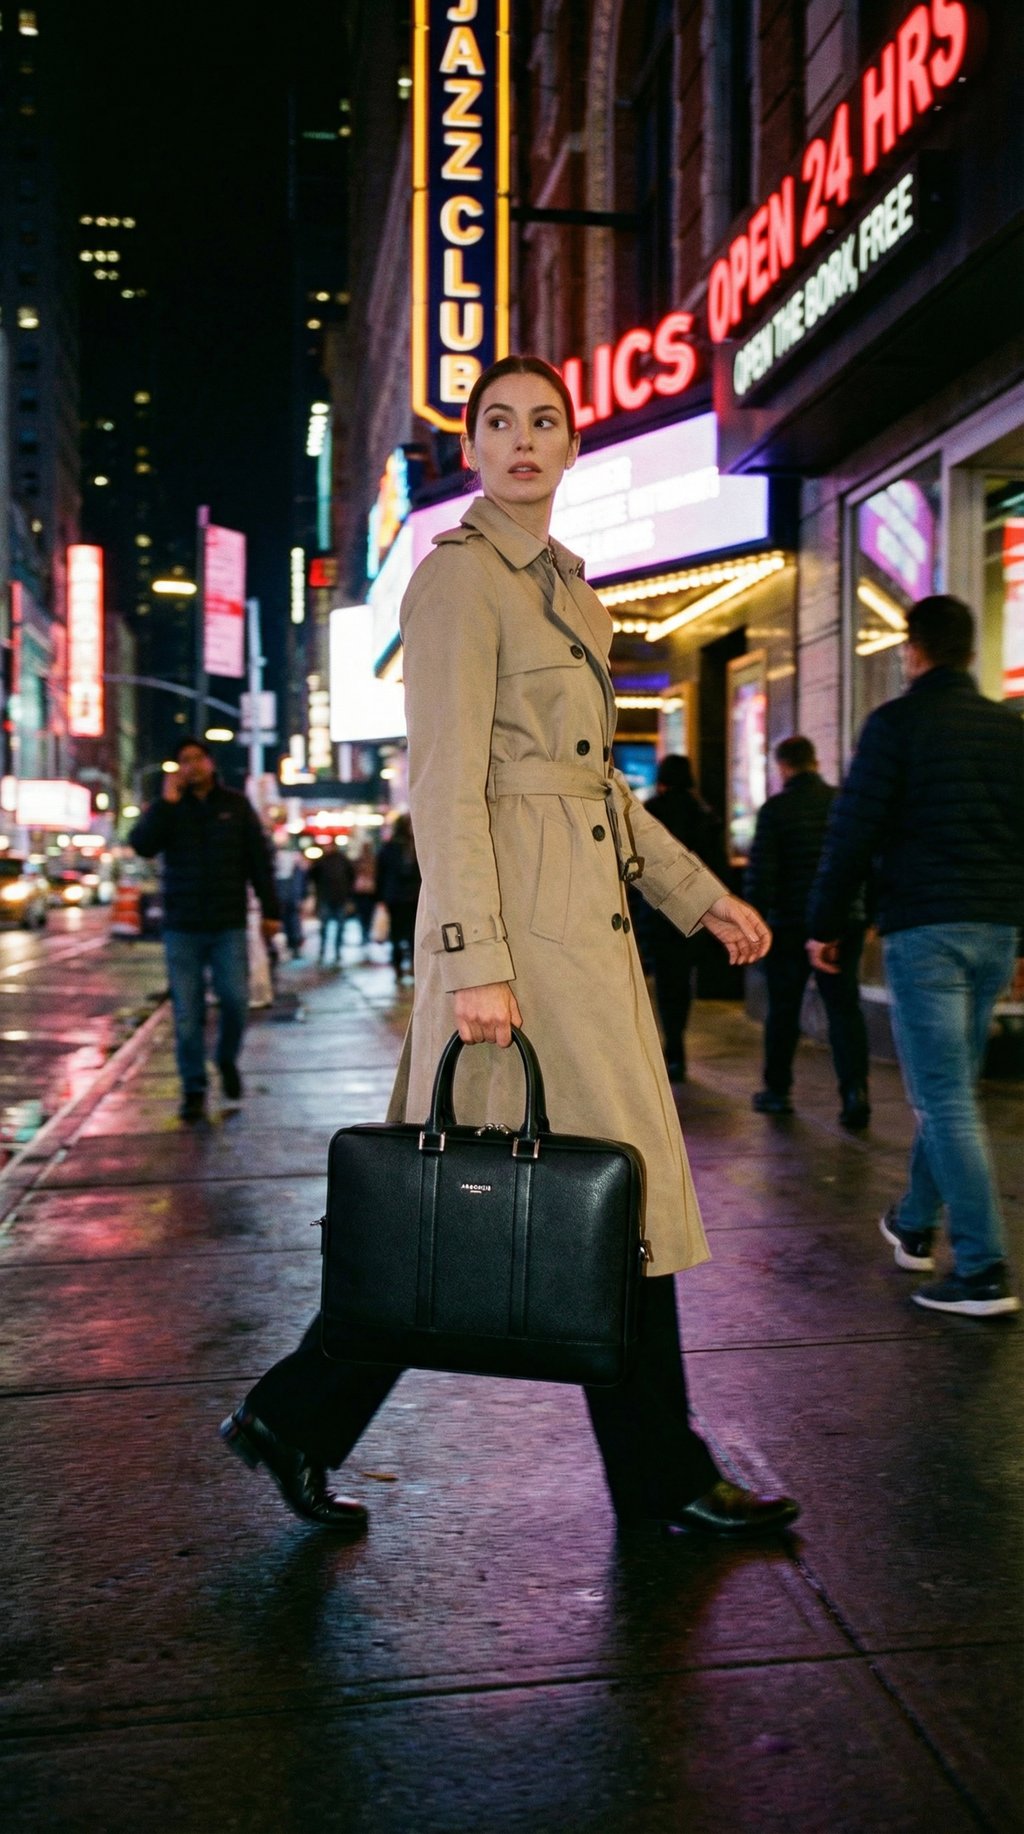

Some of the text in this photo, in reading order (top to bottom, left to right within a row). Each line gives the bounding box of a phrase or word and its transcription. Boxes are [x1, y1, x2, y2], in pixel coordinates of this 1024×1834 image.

[708, 0, 967, 343] OPEN 24 HRS
[439, 195, 485, 403] CLUB
[733, 322, 773, 396] OPEN
[772, 290, 805, 358] THE
[859, 173, 914, 272] FREE
